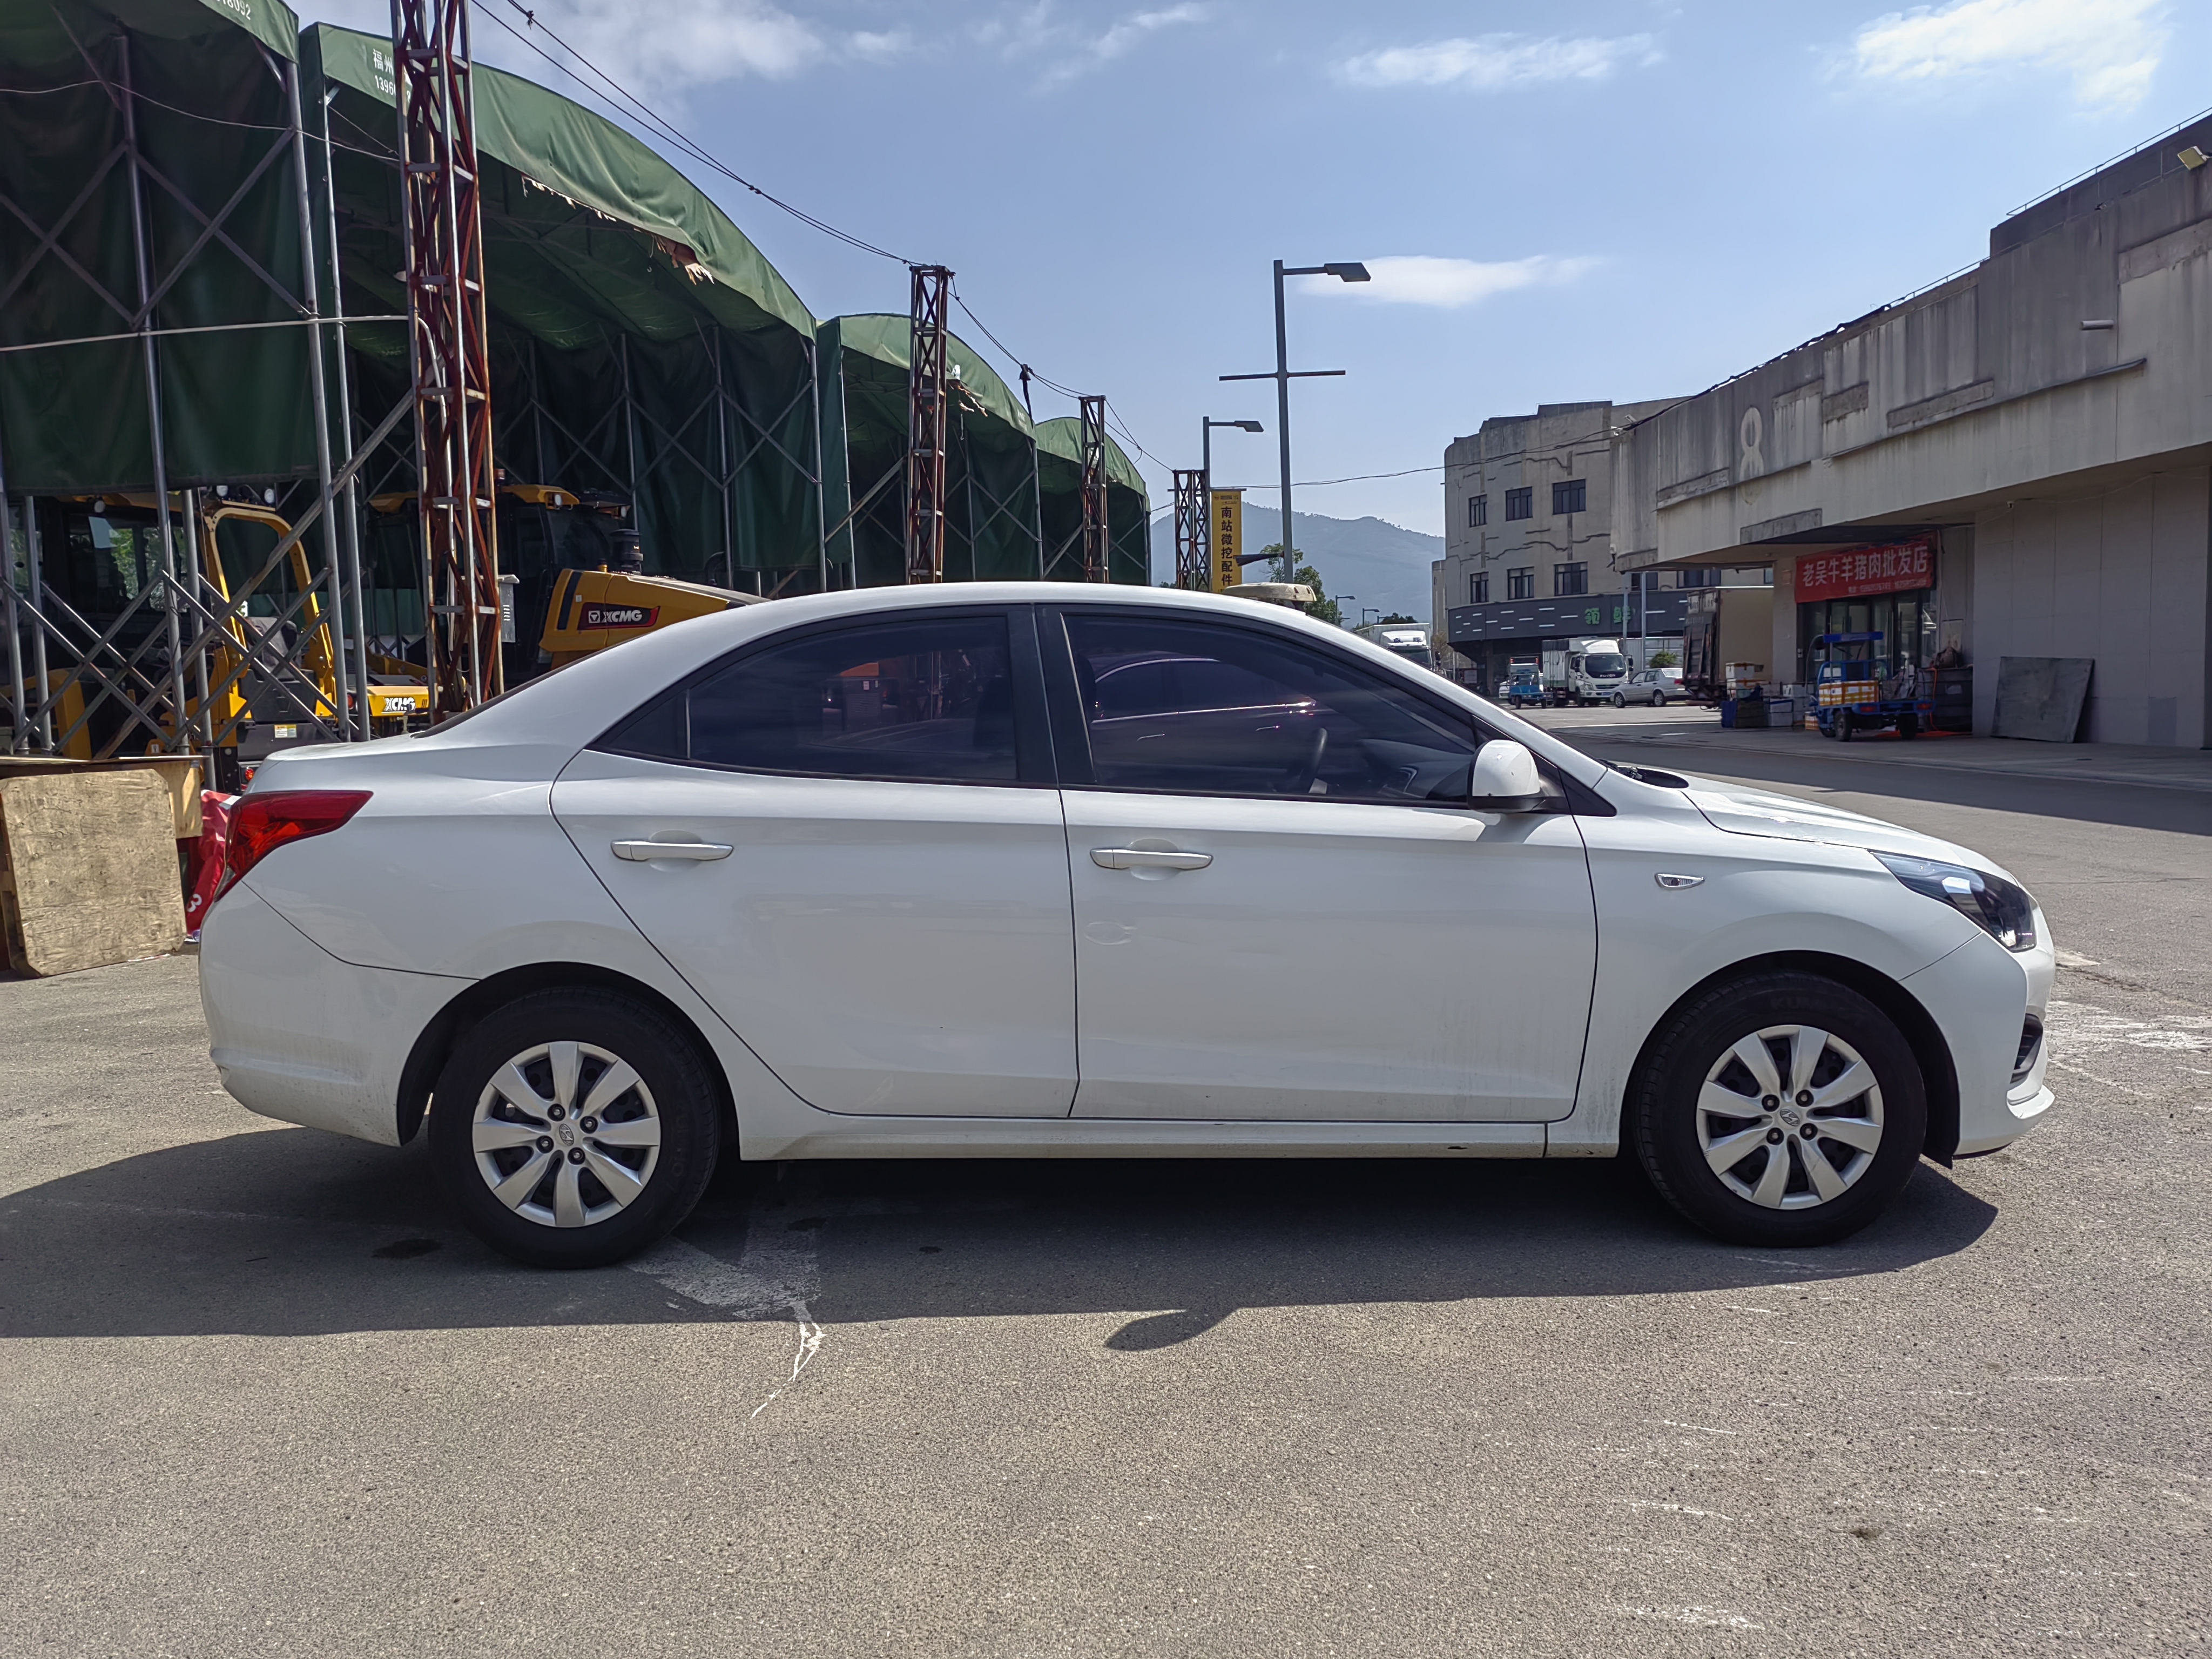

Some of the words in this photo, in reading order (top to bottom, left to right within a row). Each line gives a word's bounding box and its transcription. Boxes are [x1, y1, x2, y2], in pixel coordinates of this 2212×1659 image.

[1221, 506, 1233, 586] 南站微挖配件
[1802, 545, 1928, 587] 老吴牛羊猪肉批发店
[601, 610, 643, 623] XCMG
[384, 697, 415, 711] XCMG
